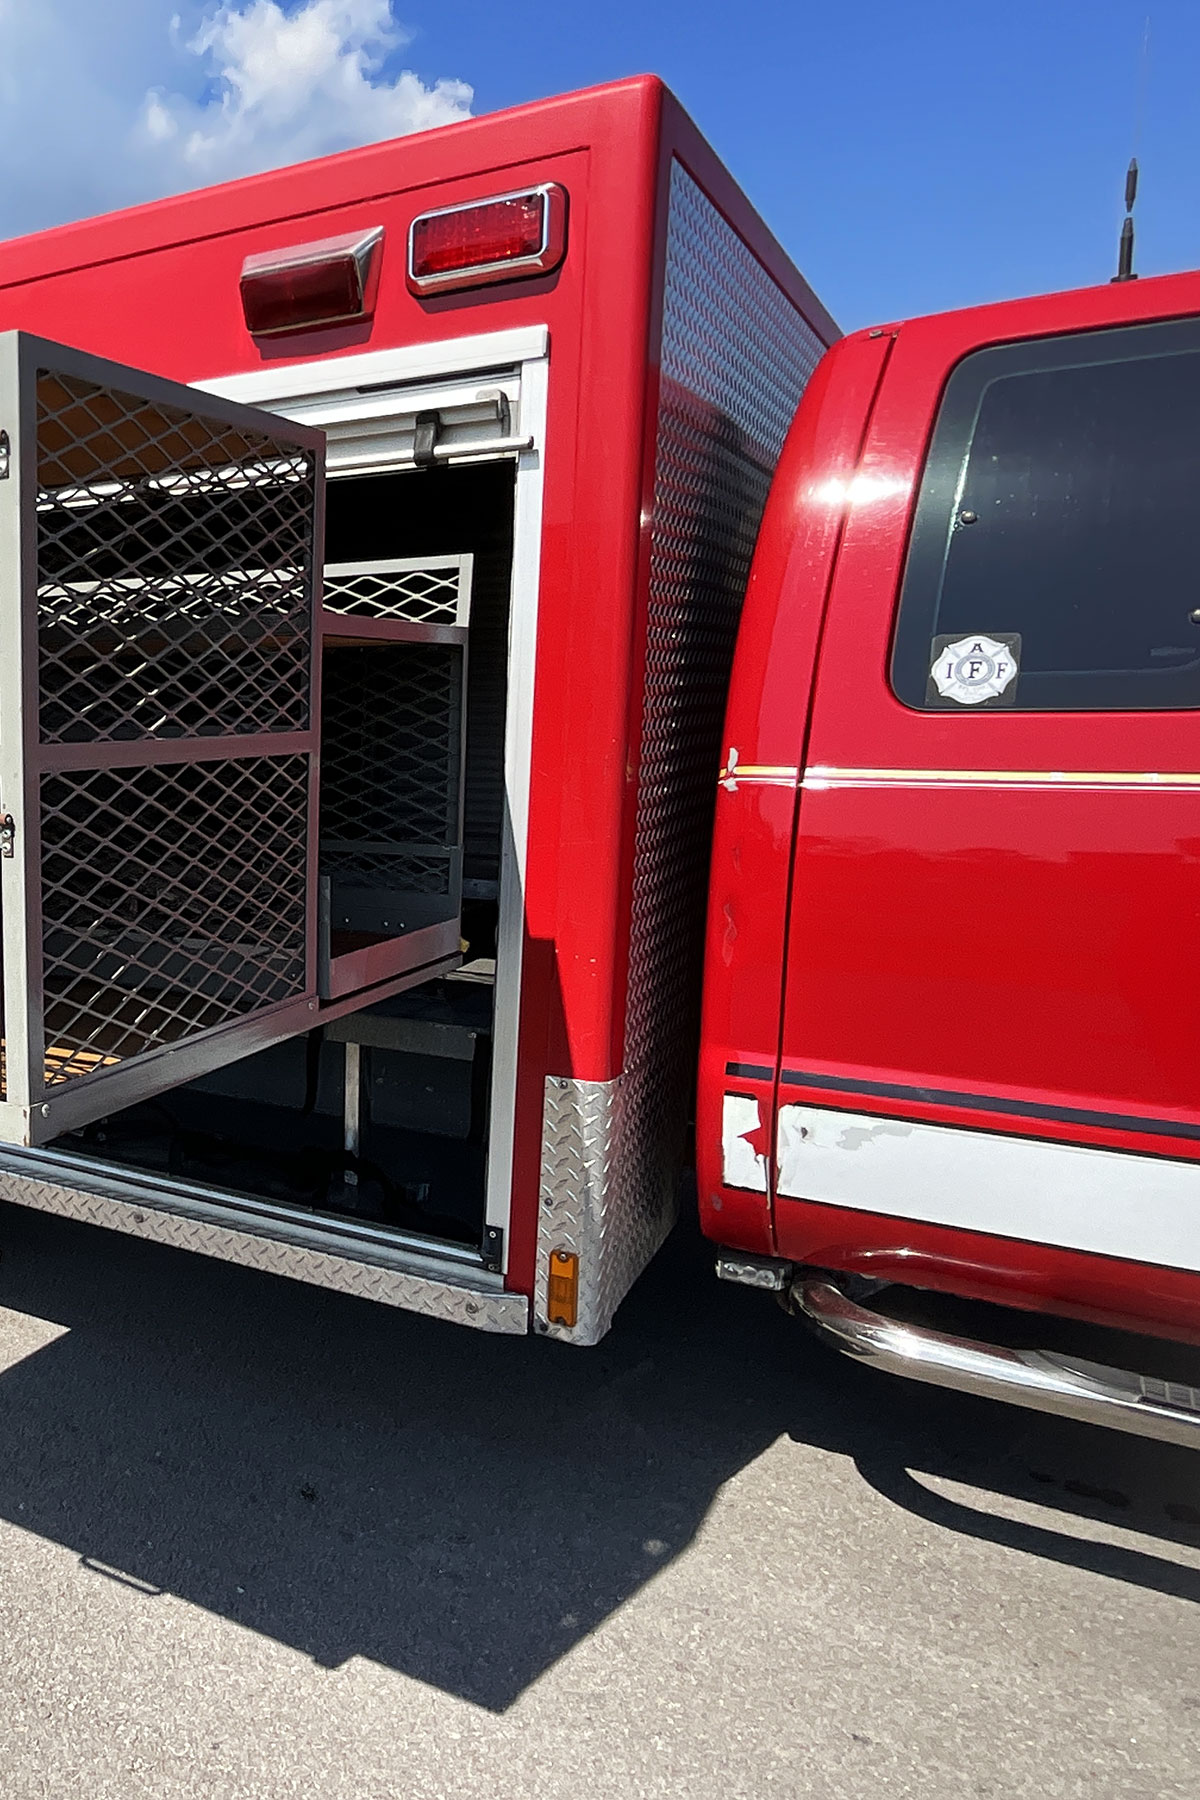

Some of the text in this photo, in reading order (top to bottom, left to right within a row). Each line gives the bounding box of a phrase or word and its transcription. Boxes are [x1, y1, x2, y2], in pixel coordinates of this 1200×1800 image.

[969, 643, 984, 654] A
[946, 661, 1009, 679] I F F
